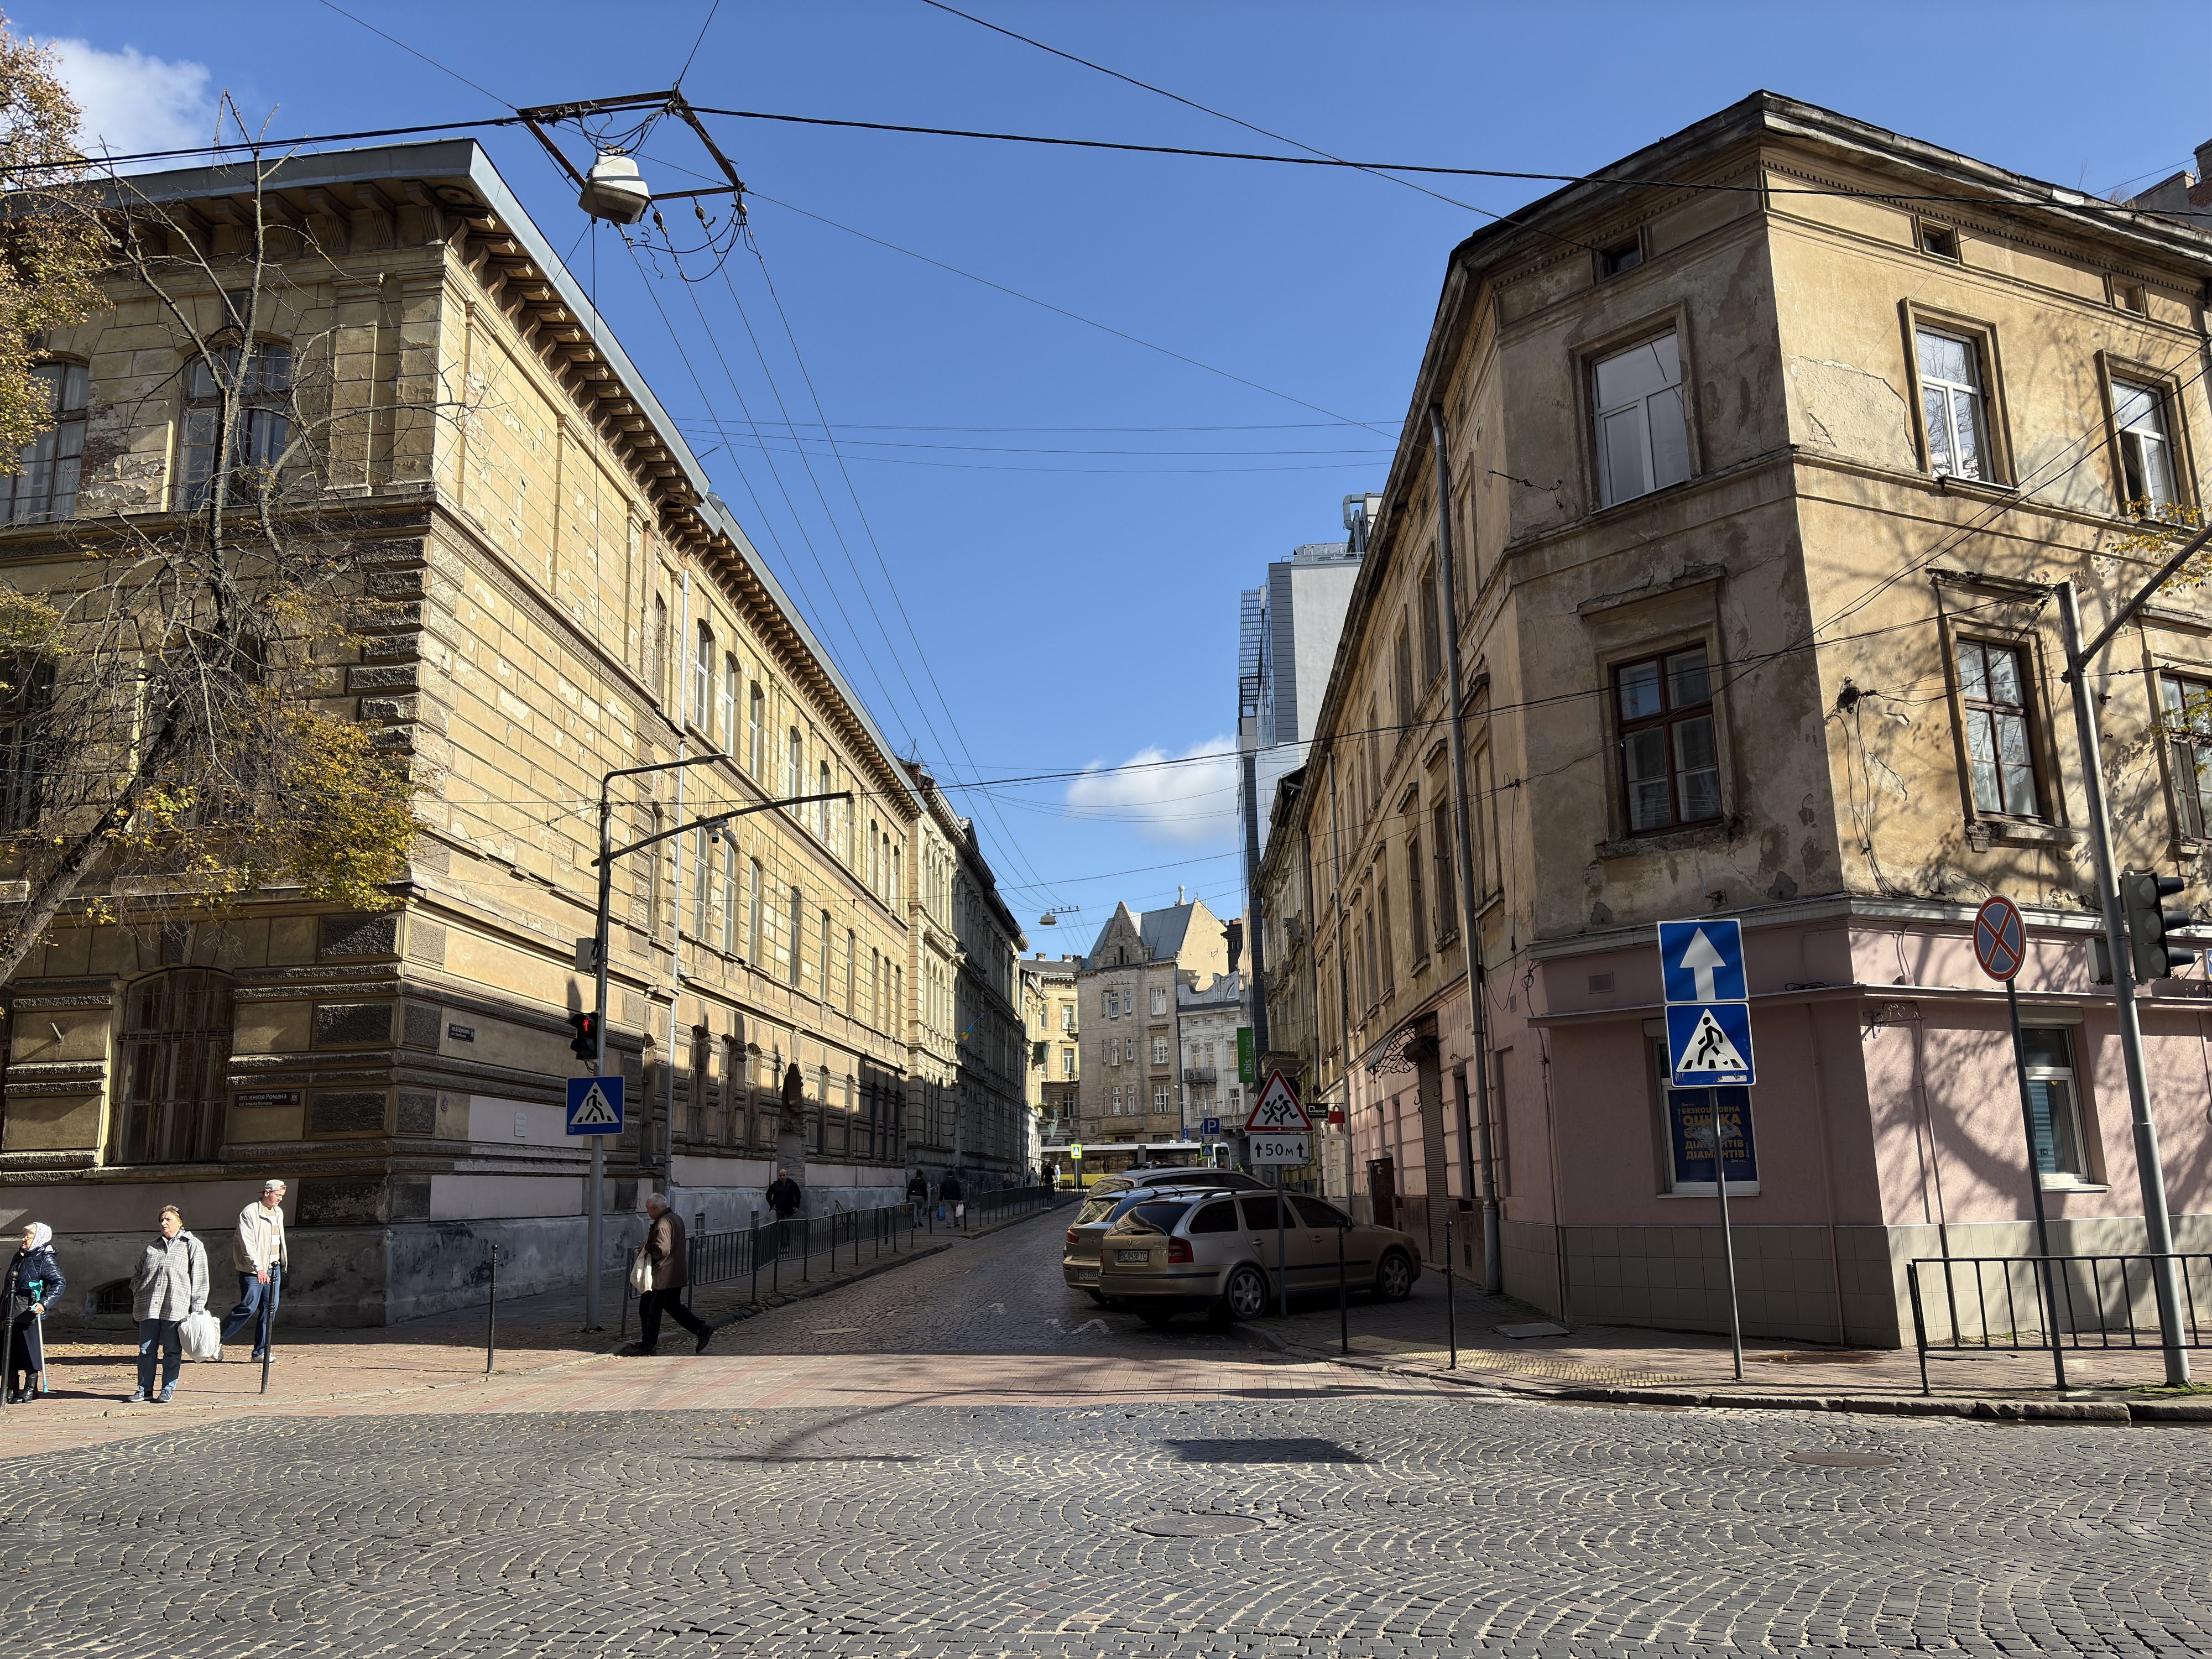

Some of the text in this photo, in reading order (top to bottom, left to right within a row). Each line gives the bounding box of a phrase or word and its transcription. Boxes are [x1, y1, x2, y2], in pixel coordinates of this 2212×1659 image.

[1243, 1059, 1252, 1074] ibis
[1208, 1120, 1217, 1133] P
[1686, 1150, 1745, 1160] ДІАМНТІВ
